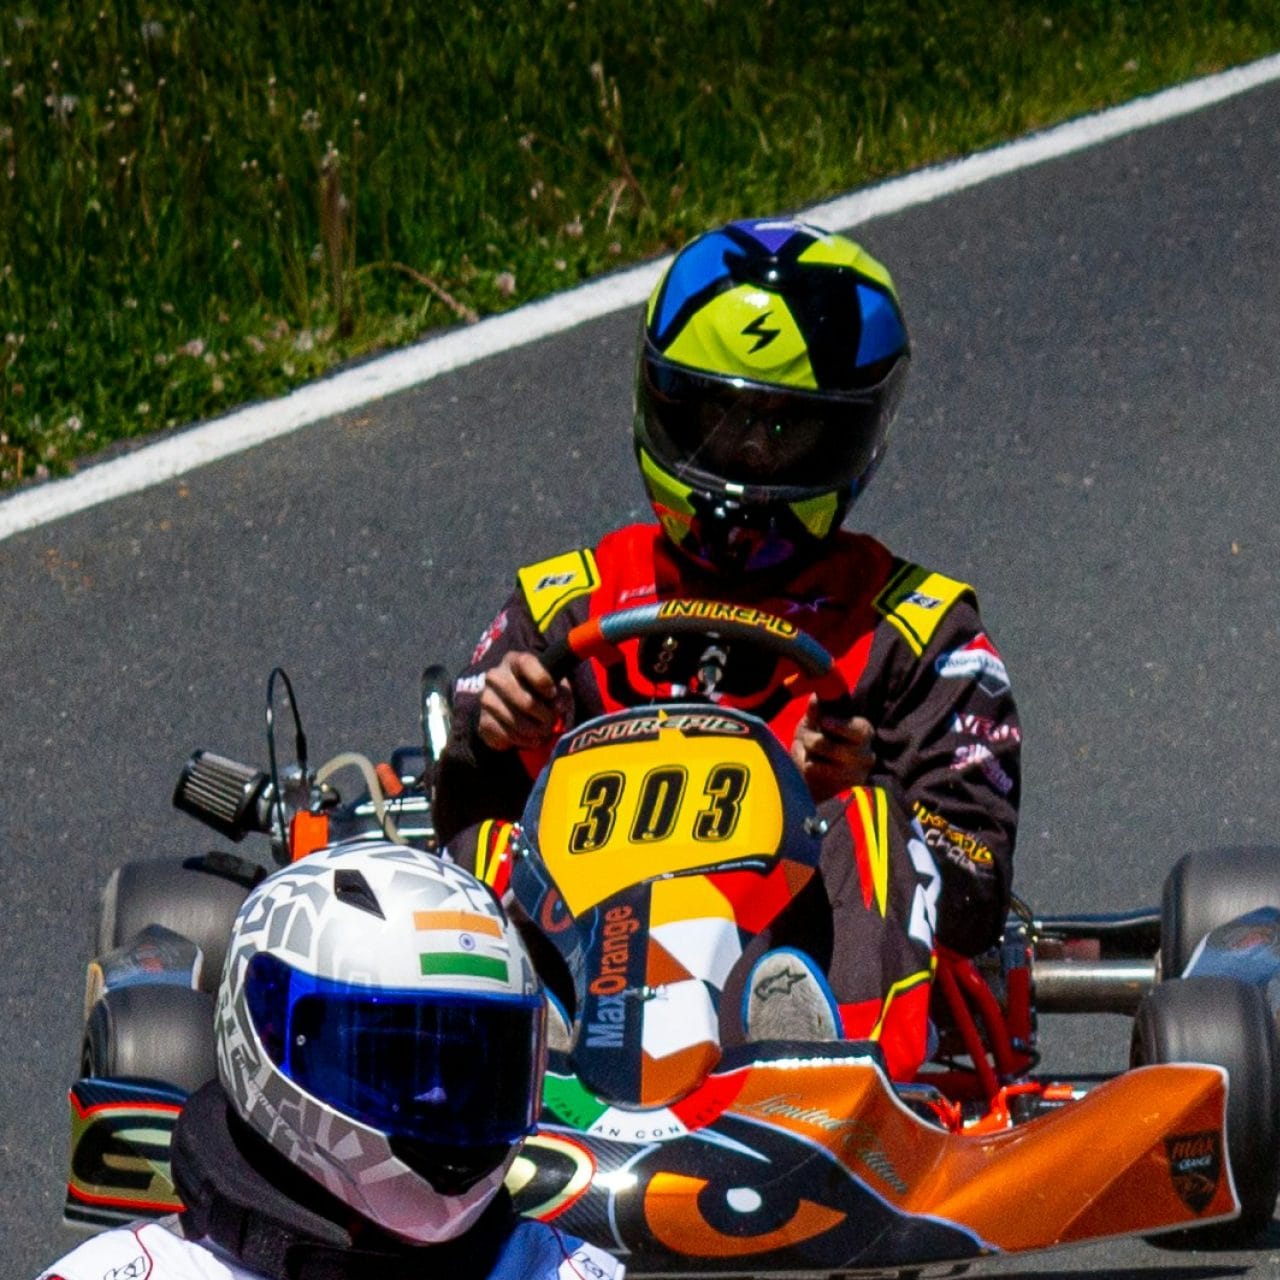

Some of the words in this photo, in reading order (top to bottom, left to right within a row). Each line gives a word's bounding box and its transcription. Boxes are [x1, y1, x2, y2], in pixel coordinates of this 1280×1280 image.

[658, 598, 799, 639] INTREPID
[569, 714, 750, 753] INTREPID
[568, 762, 750, 855] 303
